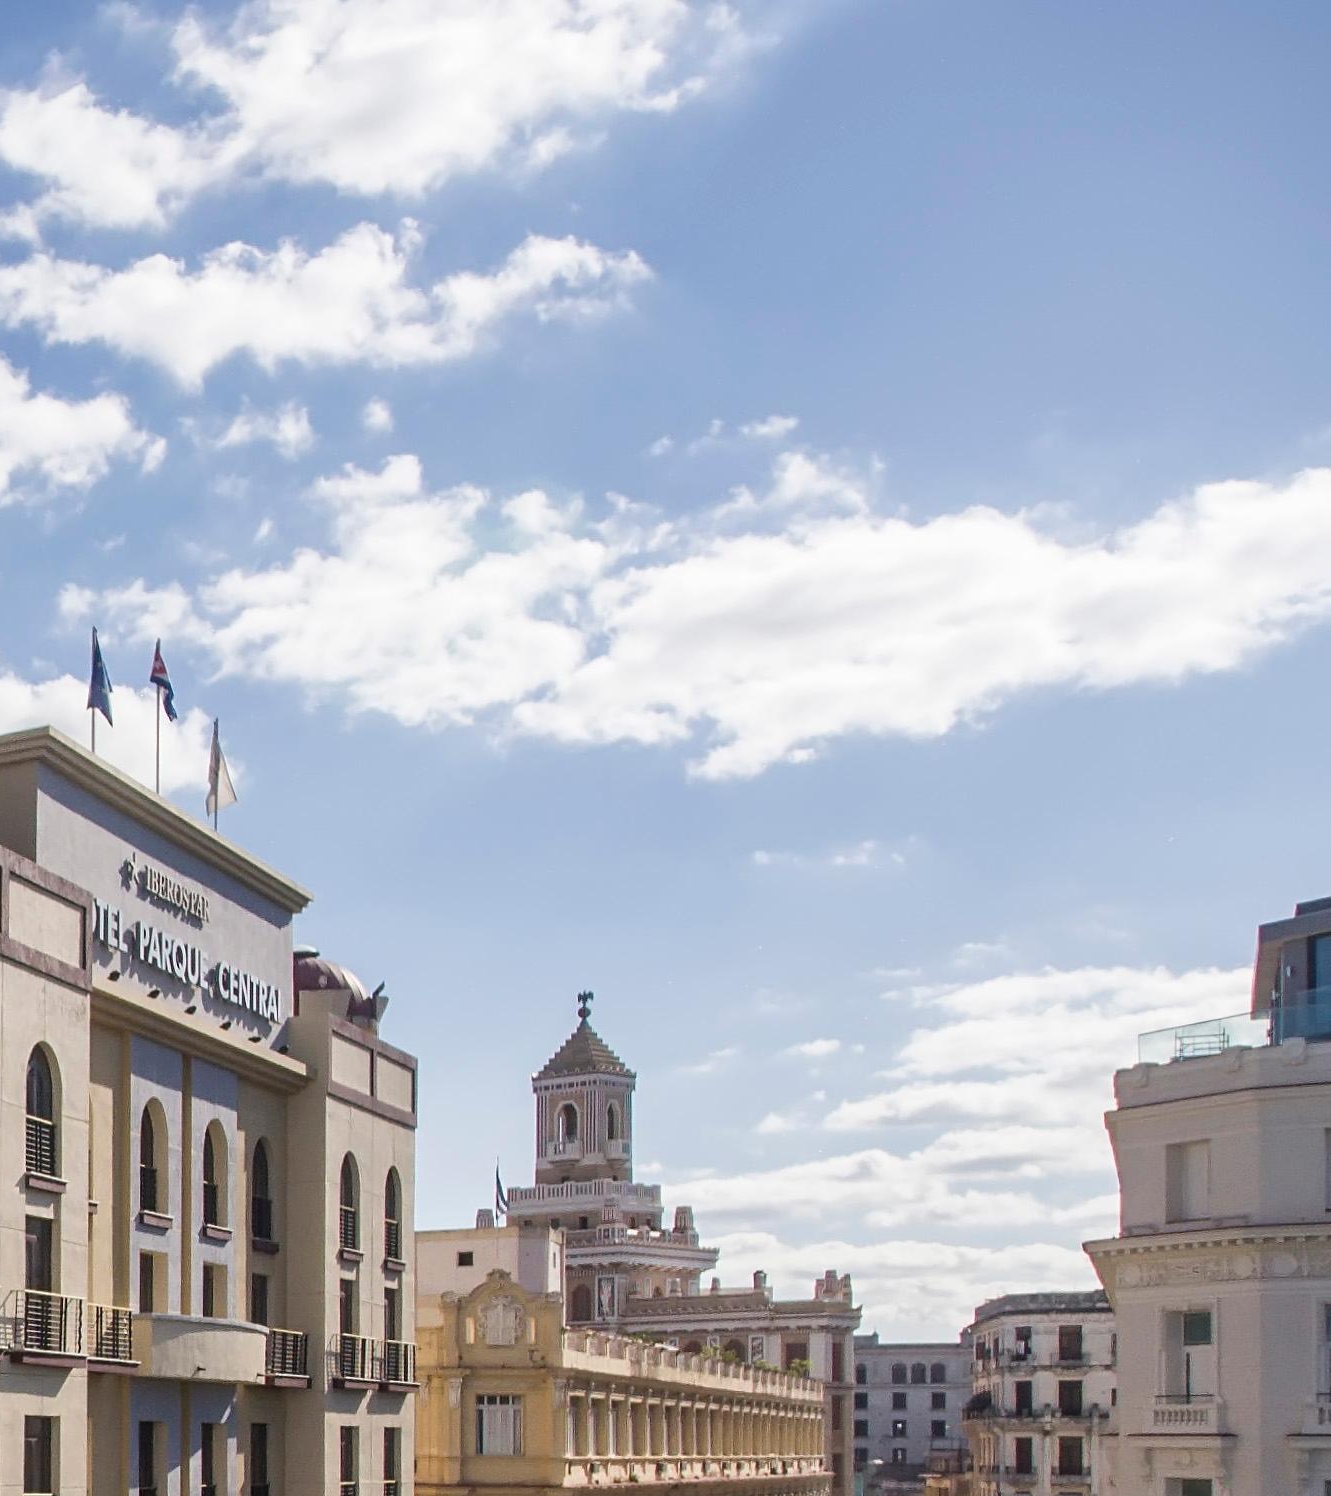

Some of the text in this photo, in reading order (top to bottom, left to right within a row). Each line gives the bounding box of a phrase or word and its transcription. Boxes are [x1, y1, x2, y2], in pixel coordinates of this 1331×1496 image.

[145, 865, 210, 922] IBEROSTAR
[139, 920, 209, 990] PARQUE
[218, 960, 283, 1024] CENTRAL
